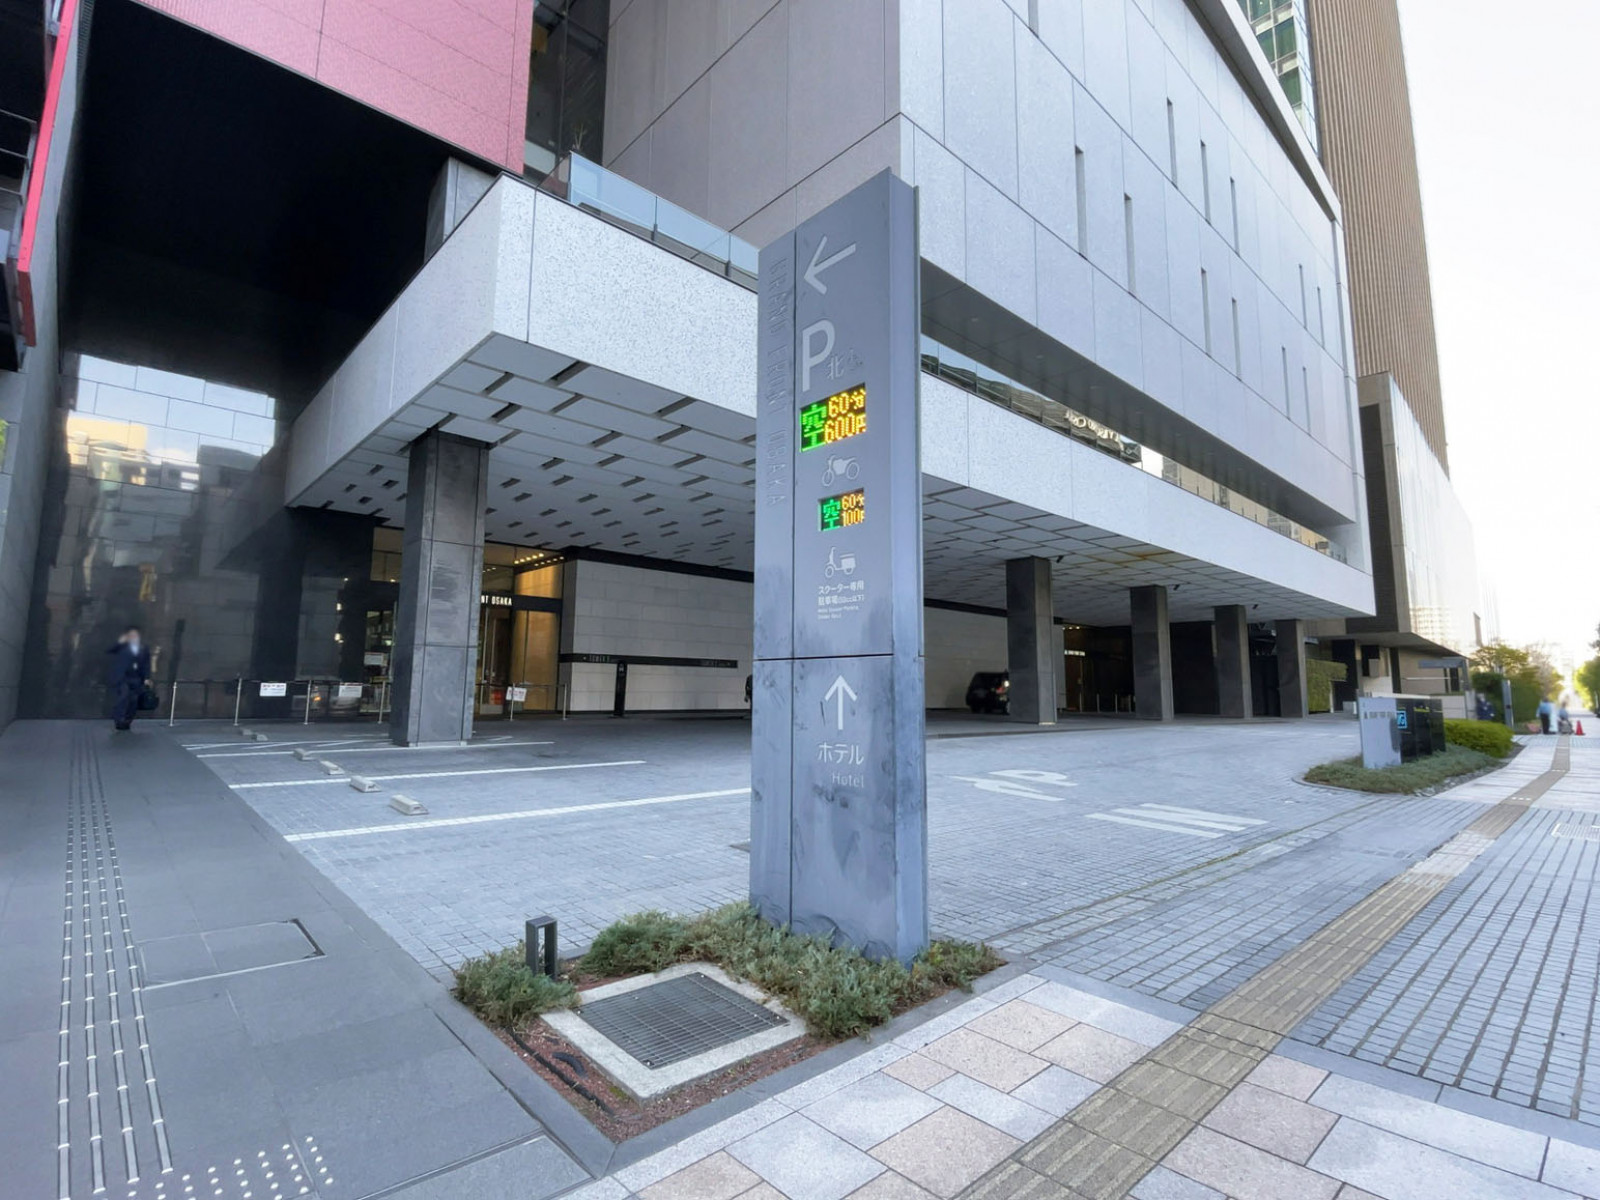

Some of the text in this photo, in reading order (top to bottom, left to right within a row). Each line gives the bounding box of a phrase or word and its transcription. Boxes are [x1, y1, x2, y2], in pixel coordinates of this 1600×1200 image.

[802, 319, 836, 392] P
[802, 403, 827, 452] 空
[767, 429, 787, 507] OSAKA
[823, 498, 841, 531] 空
[491, 596, 512, 606] OSAKA
[818, 741, 864, 765] ホテル
[832, 771, 865, 788] Hotel
